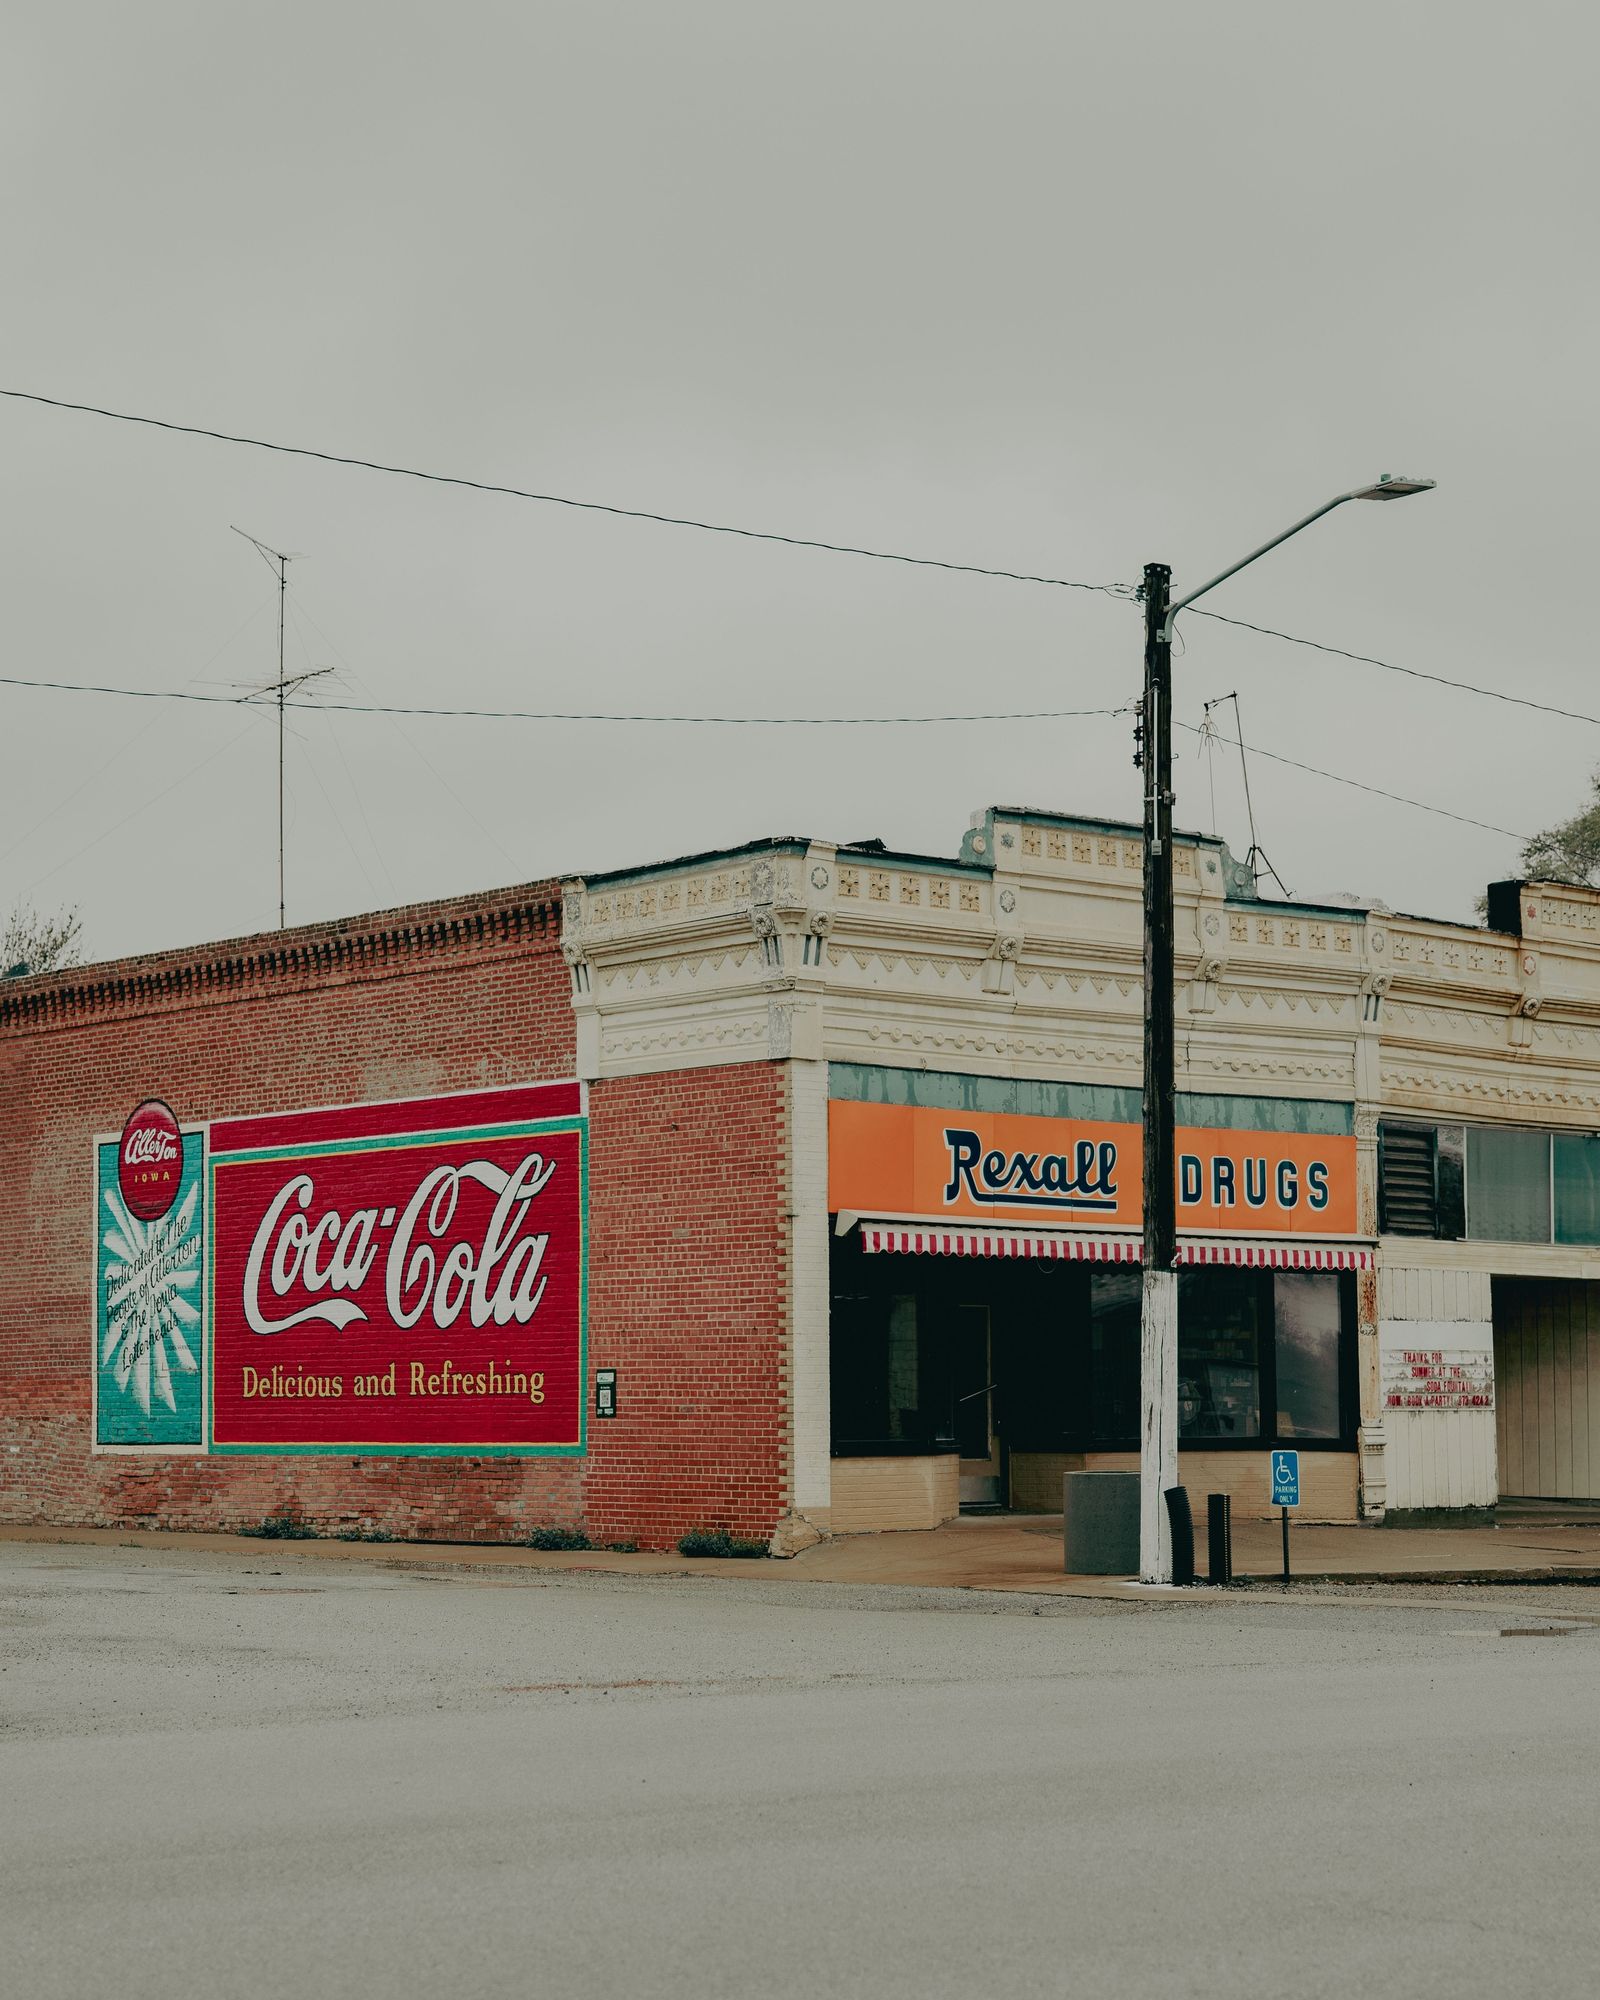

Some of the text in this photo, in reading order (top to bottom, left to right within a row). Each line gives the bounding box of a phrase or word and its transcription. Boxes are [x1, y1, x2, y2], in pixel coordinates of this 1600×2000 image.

[943, 1128, 1331, 1213] Rexall DRUGS
[134, 1171, 170, 1184] IOWA
[243, 1152, 558, 1336] Coca-Cola
[106, 1215, 188, 1301] Dedicated to The
[106, 1235, 199, 1334] People of Allerton
[120, 1283, 178, 1341] & The Iowa
[1403, 1352, 1442, 1364] THANKS FOR
[1411, 1366, 1460, 1378] SUMMER AT THE
[242, 1358, 545, 1405] Delicious and Refreshing
[1426, 1380, 1441, 1393] SODA
[1408, 1395, 1422, 1407] BOOK
[1275, 1485, 1297, 1494] PARKING
[1280, 1495, 1293, 1503] ONLY
